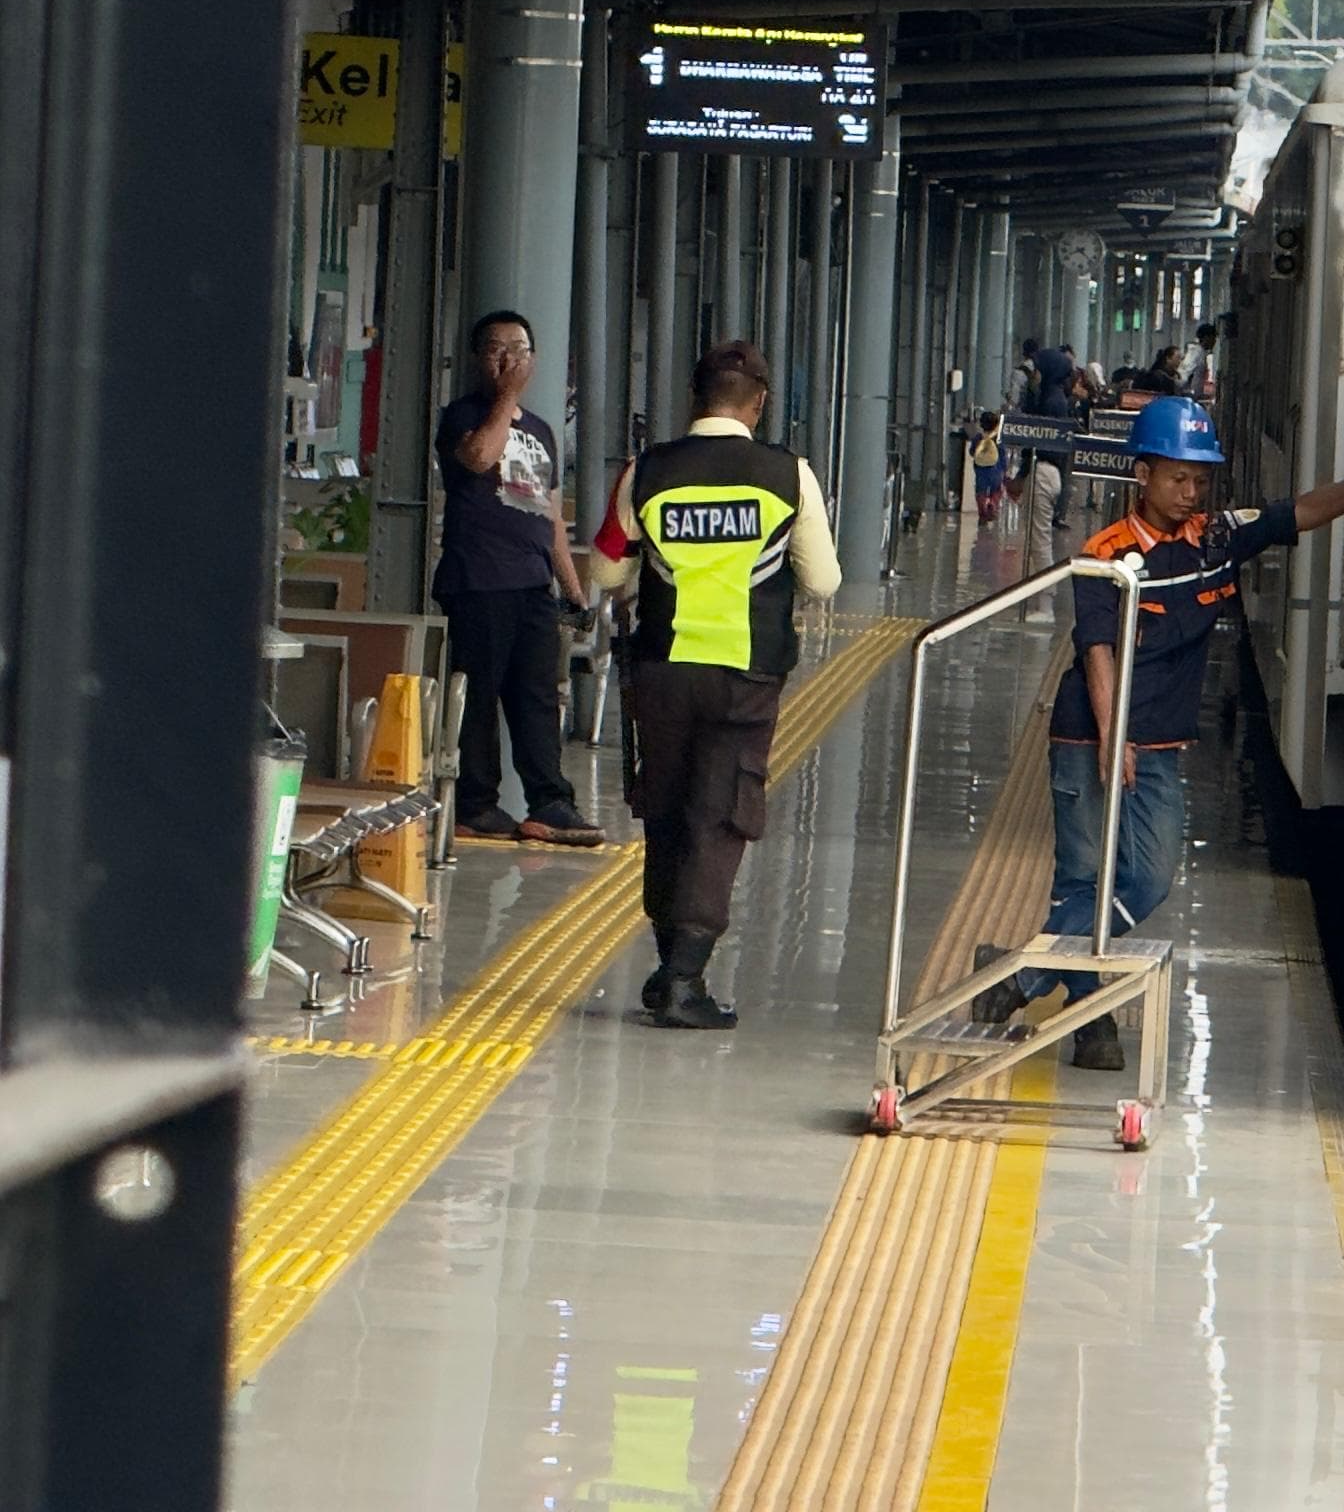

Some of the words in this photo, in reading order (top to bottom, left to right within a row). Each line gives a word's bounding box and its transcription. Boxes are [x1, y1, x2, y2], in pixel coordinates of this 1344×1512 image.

[1002, 423, 1060, 440] EKSEKUTIF
[1093, 419, 1136, 432] EKSEKUT
[1073, 450, 1137, 471] EKSEKUT
[665, 506, 758, 539] SATPAM
